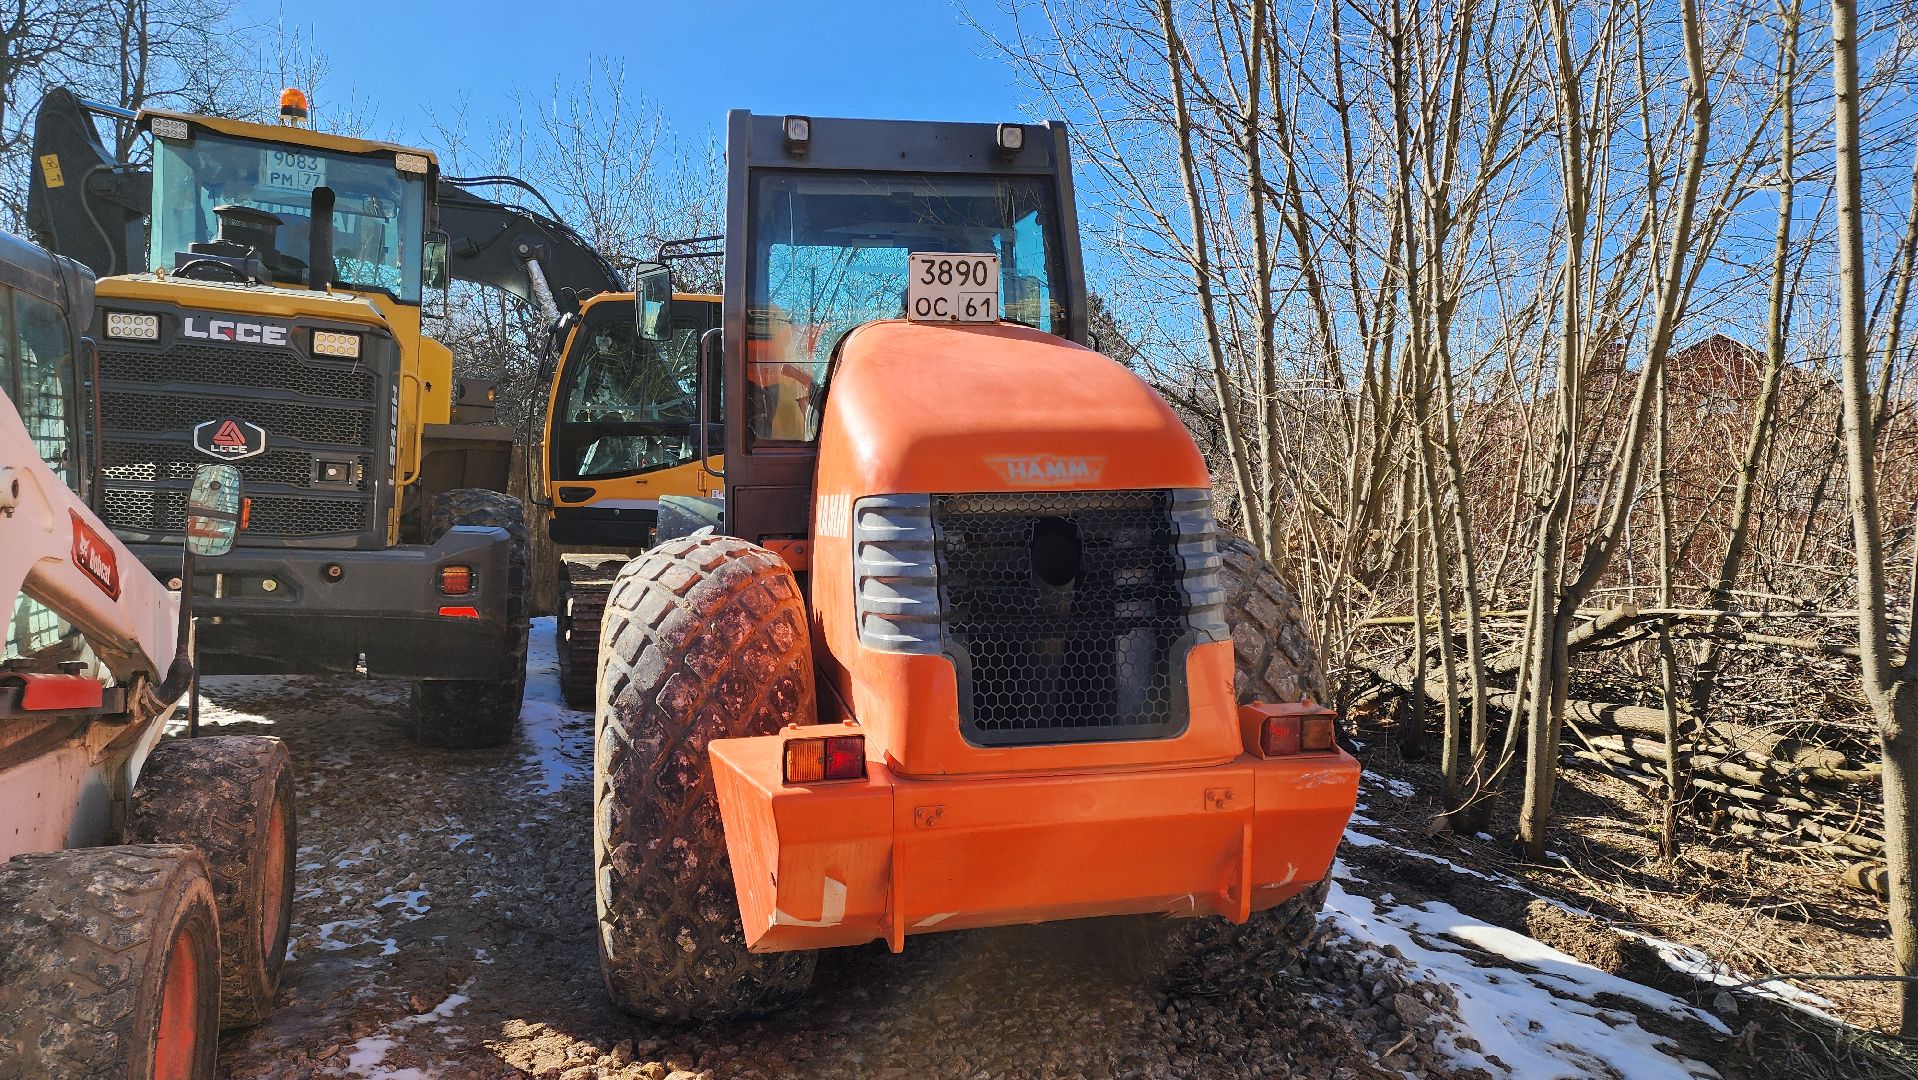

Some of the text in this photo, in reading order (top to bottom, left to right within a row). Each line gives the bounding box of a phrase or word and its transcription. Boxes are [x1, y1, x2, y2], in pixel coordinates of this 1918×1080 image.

[274, 152, 317, 170] 9083
[304, 173, 320, 186] 77
[921, 260, 987, 286] 3890
[966, 297, 991, 317] 61
[1007, 459, 1090, 482] HAMM
